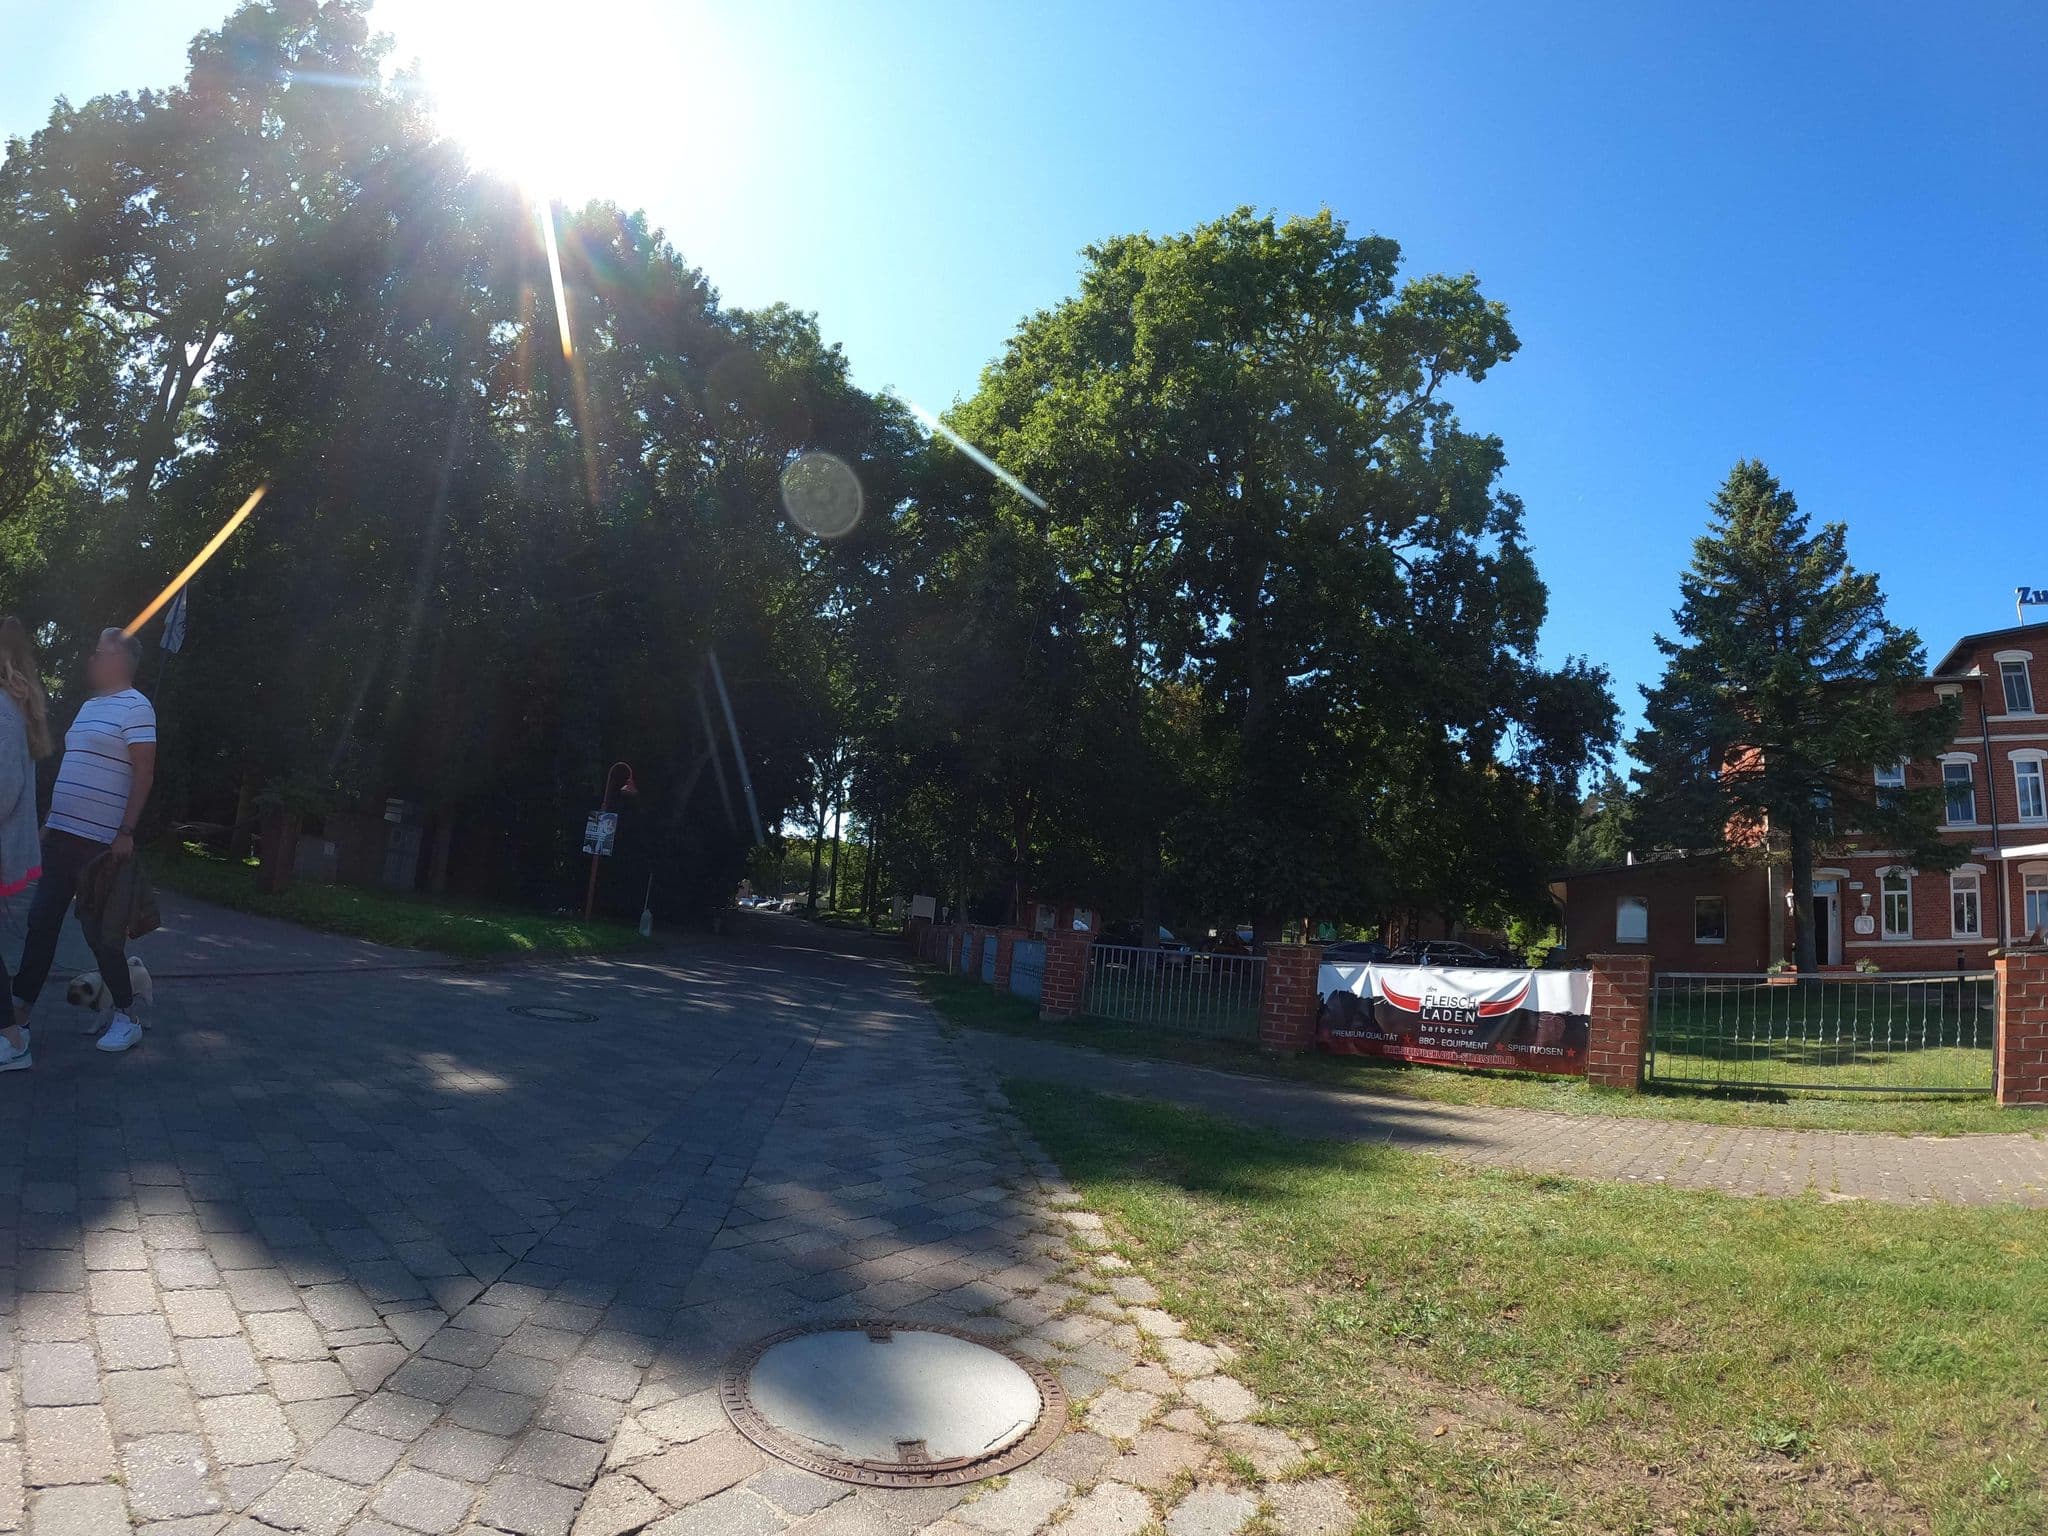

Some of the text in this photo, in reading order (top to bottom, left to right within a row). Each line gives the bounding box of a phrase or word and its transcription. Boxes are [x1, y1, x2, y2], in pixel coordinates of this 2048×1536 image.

[1425, 995, 1476, 1009] FLEISCH
[1422, 1008, 1475, 1023] LADEN
[1421, 1024, 1474, 1036] barbecue
[1418, 1037, 1436, 1045] BBQ
[1441, 1038, 1489, 1050] EQUIPMENT
[1507, 1043, 1564, 1056] SPIRITUOSEN
